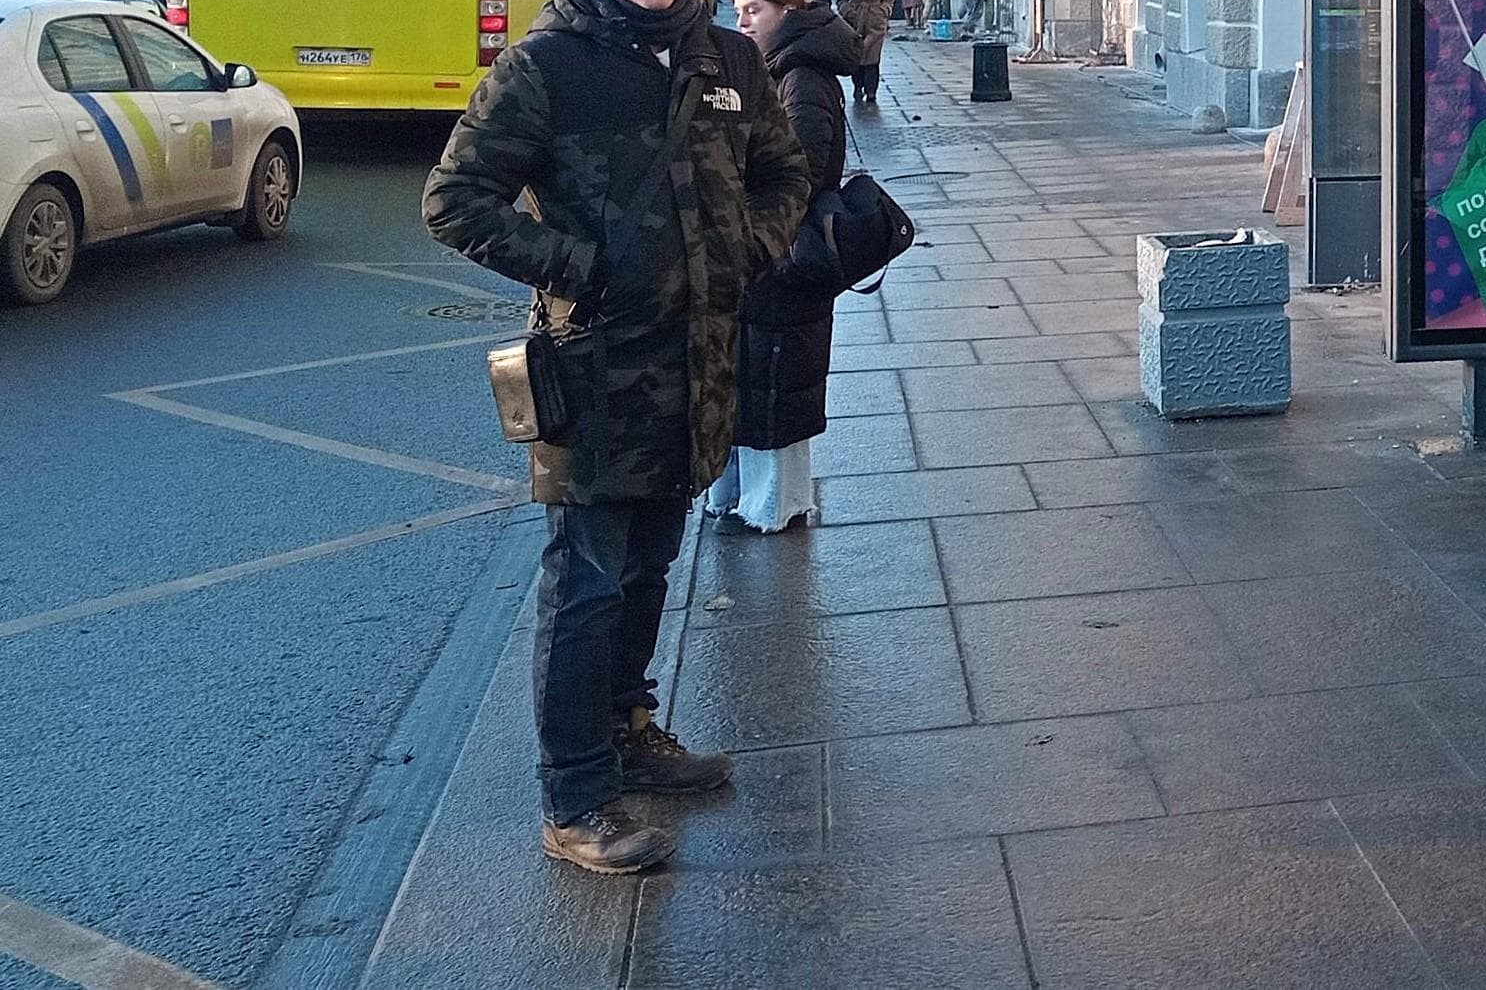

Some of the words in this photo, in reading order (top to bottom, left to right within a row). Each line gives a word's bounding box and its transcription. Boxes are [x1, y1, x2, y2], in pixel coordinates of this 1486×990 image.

[714, 86, 729, 95] THE
[702, 93, 730, 103] NORTH
[712, 101, 730, 111] FACE
